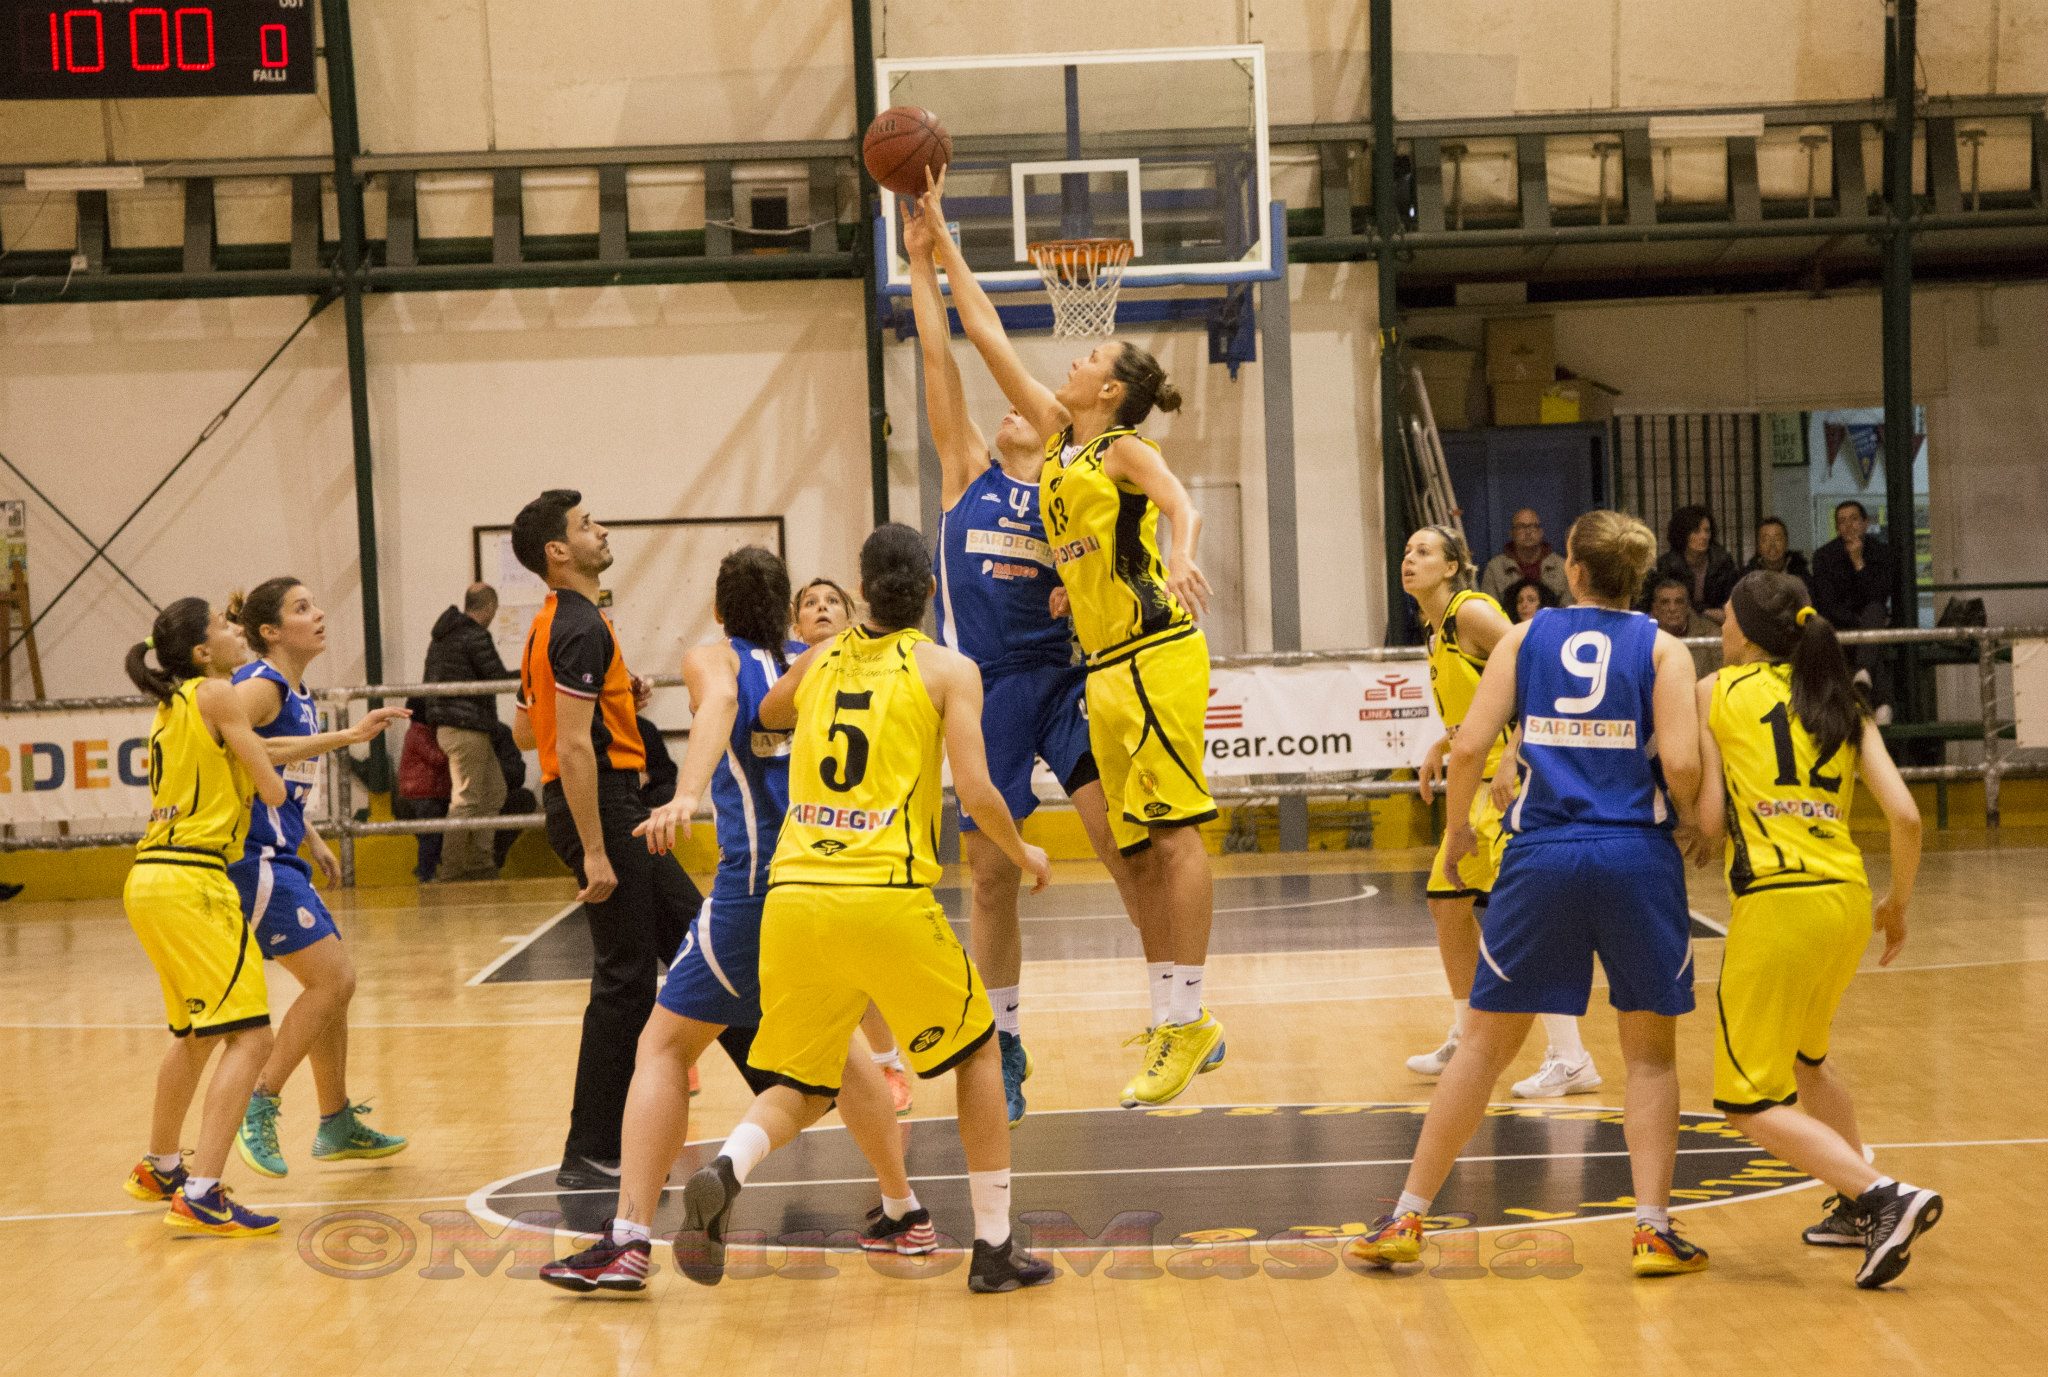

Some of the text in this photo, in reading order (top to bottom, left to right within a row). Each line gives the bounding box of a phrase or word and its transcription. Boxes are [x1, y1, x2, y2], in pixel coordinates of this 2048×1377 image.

[260, 24, 288, 68] 0
[253, 69, 287, 82] FALLI
[1009, 487, 1031, 518] 4
[1554, 630, 1612, 714] 9
[1361, 707, 1428, 720] LINEA 4 MORI
[1528, 718, 1635, 738] SARDEGNA
[819, 690, 874, 792] 5
[1204, 732, 1352, 759] ear.com
[1760, 701, 1843, 793] 12
[790, 804, 898, 830] ARDEGN
